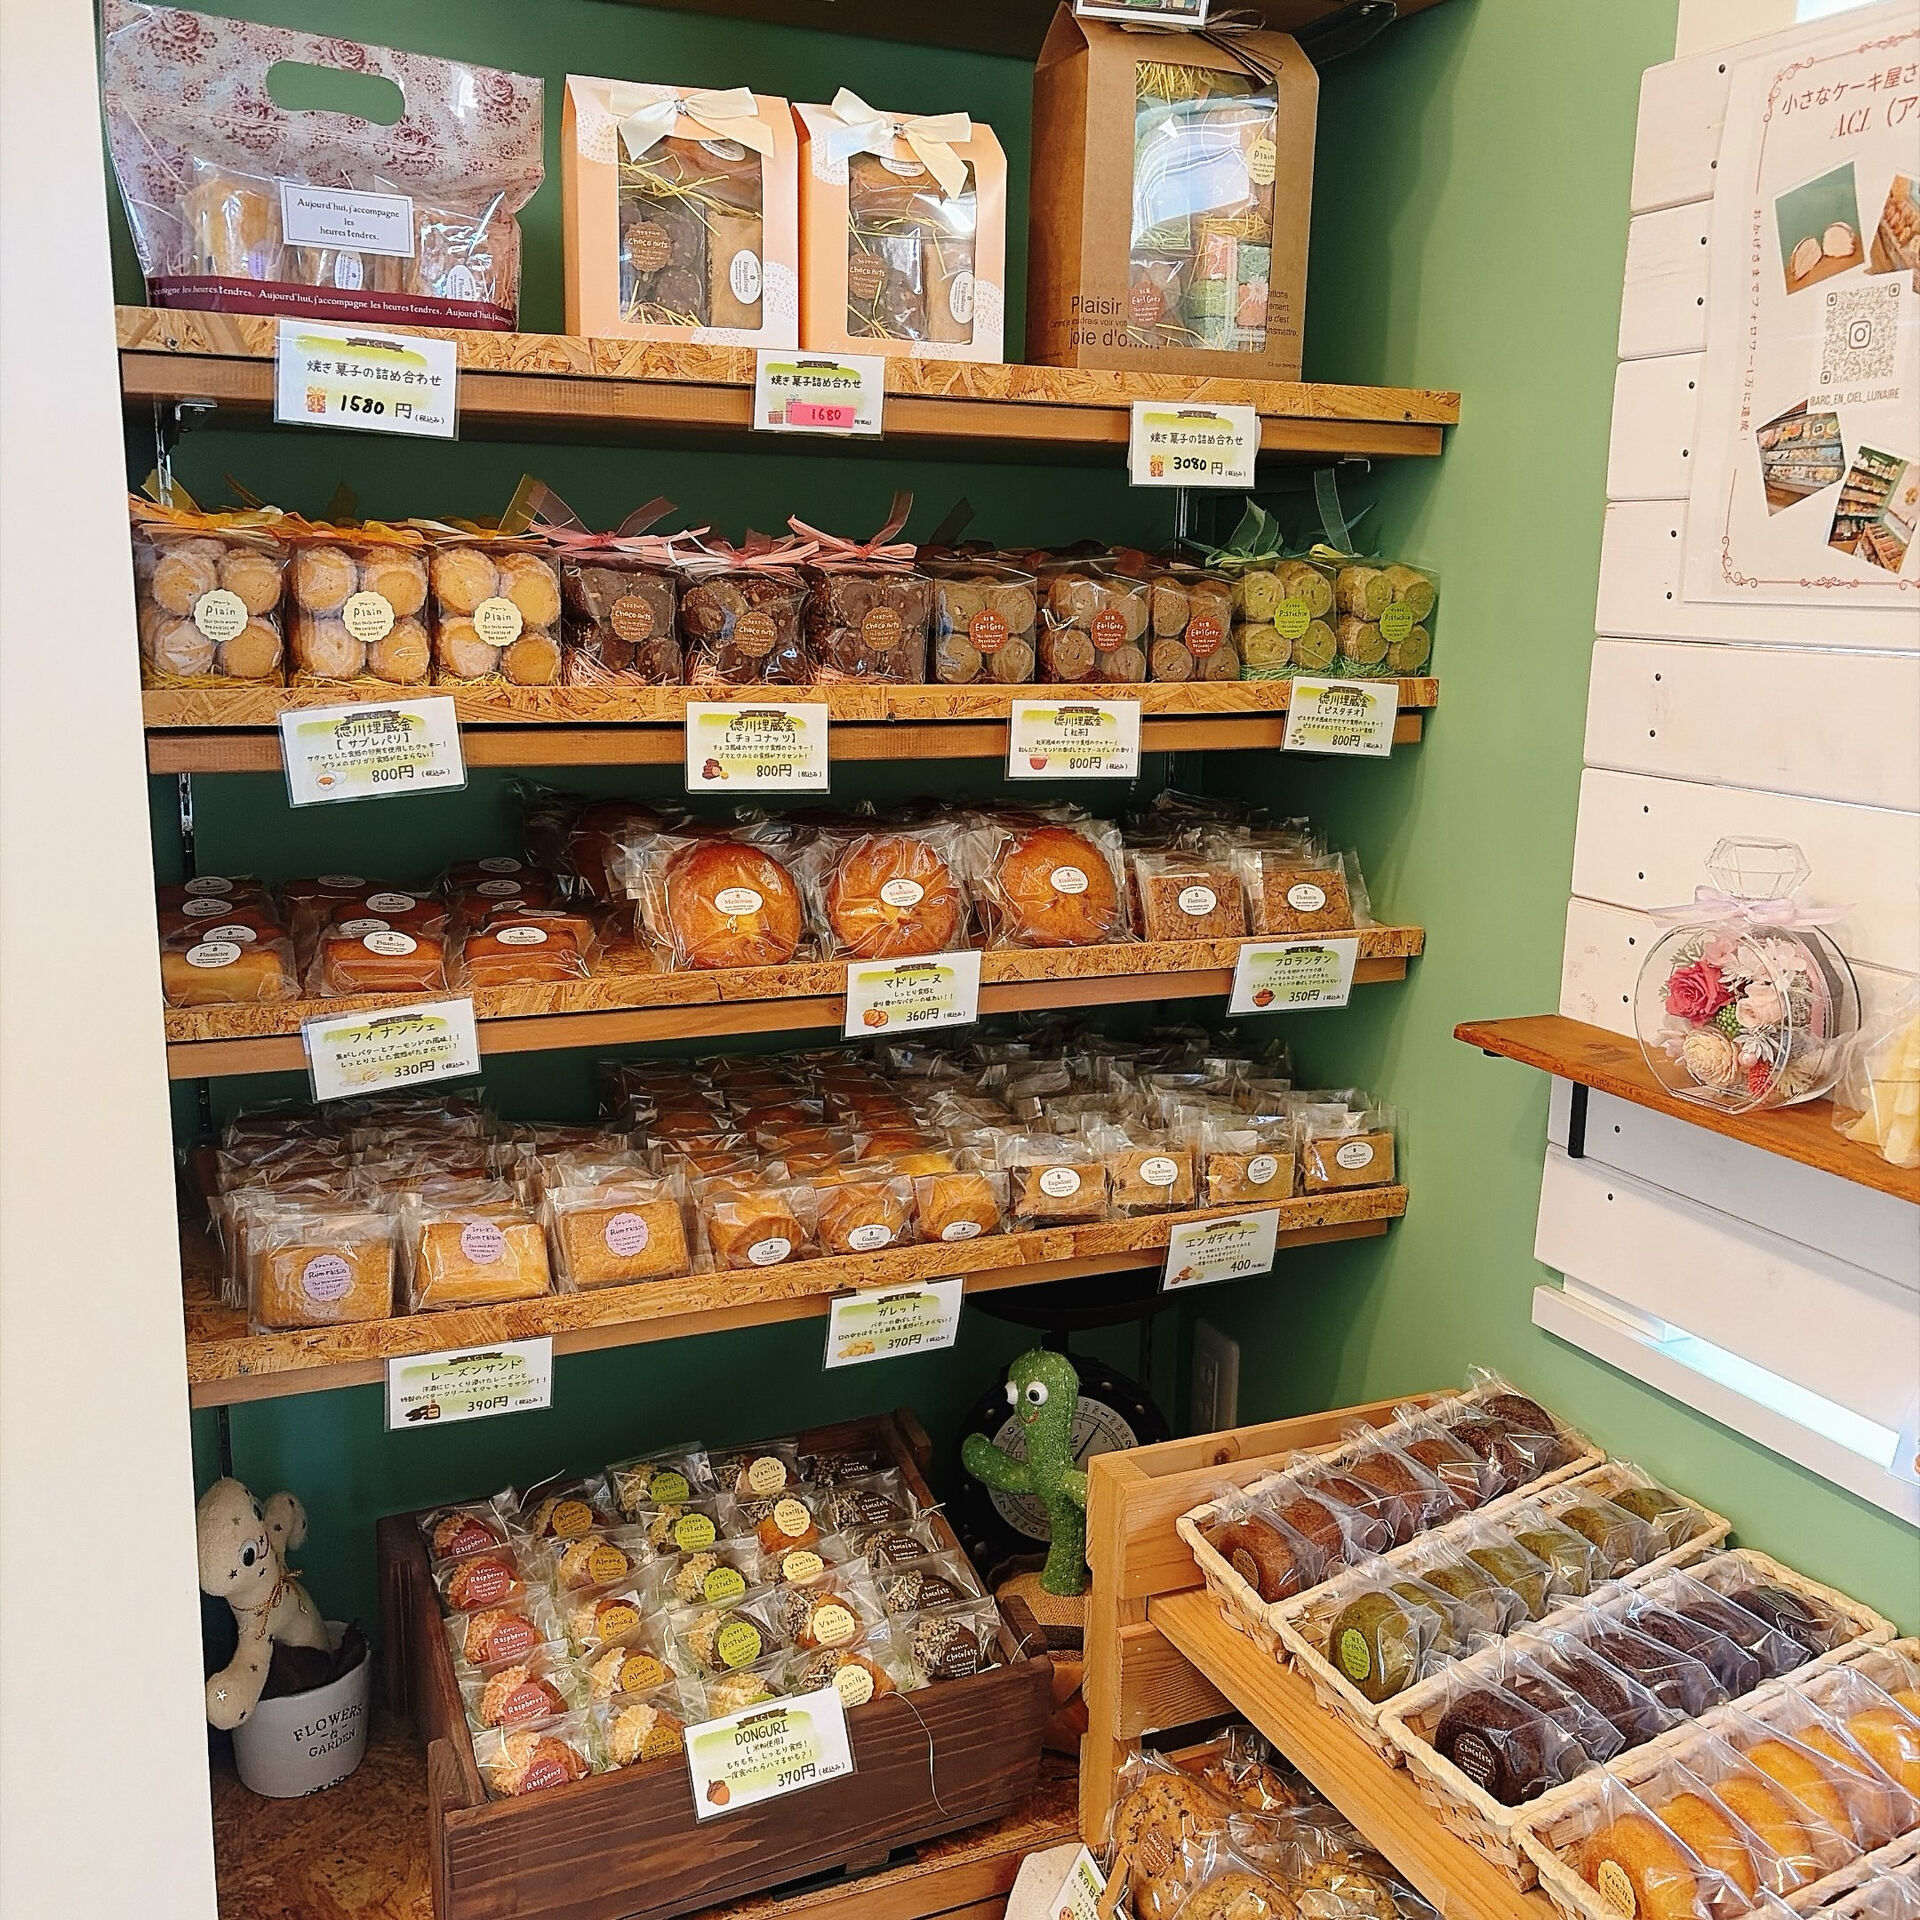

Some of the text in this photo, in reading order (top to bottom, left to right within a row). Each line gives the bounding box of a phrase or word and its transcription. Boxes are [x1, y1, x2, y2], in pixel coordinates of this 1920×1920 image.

[344, 217, 355, 227] les
[320, 227, 380, 241] heures tendres.
[219, 286, 255, 297] tendres.
[371, 301, 381, 309] les
[383, 302, 409, 312] heures
[410, 304, 442, 315] tendres.
[1071, 296, 1122, 315] Plaisir
[1070, 328, 1096, 350] joie
[306, 359, 442, 387] 焼き菓子の詰め合わせ
[771, 375, 862, 389] 焼き菓子詰め合わせ
[341, 394, 385, 415] 1580
[395, 402, 412, 420] 円
[812, 408, 842, 422] 1680
[1150, 431, 1243, 446] 焼き菓子の詰め合わせ
[1173, 456, 1207, 471] 3080
[205, 605, 236, 617] Plain
[353, 607, 382, 619] Plain
[484, 611, 512, 622] Plain
[334, 717, 414, 738] 徳川埋蔵金
[729, 718, 797, 733] 徳川埋蔵金
[337, 732, 411, 750] 【サブレパリ】
[725, 732, 797, 743] 【チョコナッツ】
[1332, 734, 1361, 747] 800円
[756, 763, 792, 778] 800円
[1069, 756, 1102, 770] 800円
[372, 764, 415, 783] 800円
[1275, 955, 1332, 966] フロランタン
[884, 973, 942, 989] マドレーヌ
[1288, 989, 1320, 1002] 350円
[906, 1008, 940, 1022] 360円
[349, 1022, 437, 1044] フィナンシェ
[394, 1060, 435, 1078] 330円
[1185, 1229, 1256, 1249] エンガディナー
[1230, 1259, 1251, 1272] 400
[308, 1271, 325, 1279] Rum
[878, 1302, 920, 1317] ガレット
[887, 1333, 922, 1350] 370円
[431, 1358, 523, 1382] レーズンサンド
[467, 1395, 508, 1413] 390円
[753, 1463, 781, 1479] Vanilla
[779, 1507, 804, 1519] Vanilla
[861, 1499, 890, 1512] Chocolate
[455, 1537, 488, 1555] Raspberry
[888, 1541, 918, 1553] Chocolate
[788, 1557, 816, 1571] Vanilla
[470, 1571, 504, 1584] Raspberry
[921, 1586, 951, 1602] Chocolate
[605, 1617, 634, 1630] Almond
[817, 1613, 849, 1629] Vanilla
[492, 1630, 530, 1646] Raspberry
[946, 1647, 979, 1663] Chocolate
[628, 1664, 656, 1683] Almond
[507, 1694, 545, 1715] Raspberry
[293, 1703, 363, 1742] FLOWERS
[735, 1718, 790, 1746] DONGURI
[308, 1727, 356, 1757] GARDEN
[649, 1738, 676, 1753] Almond
[525, 1766, 562, 1791] Raspberry
[777, 1762, 817, 1788] 370円
